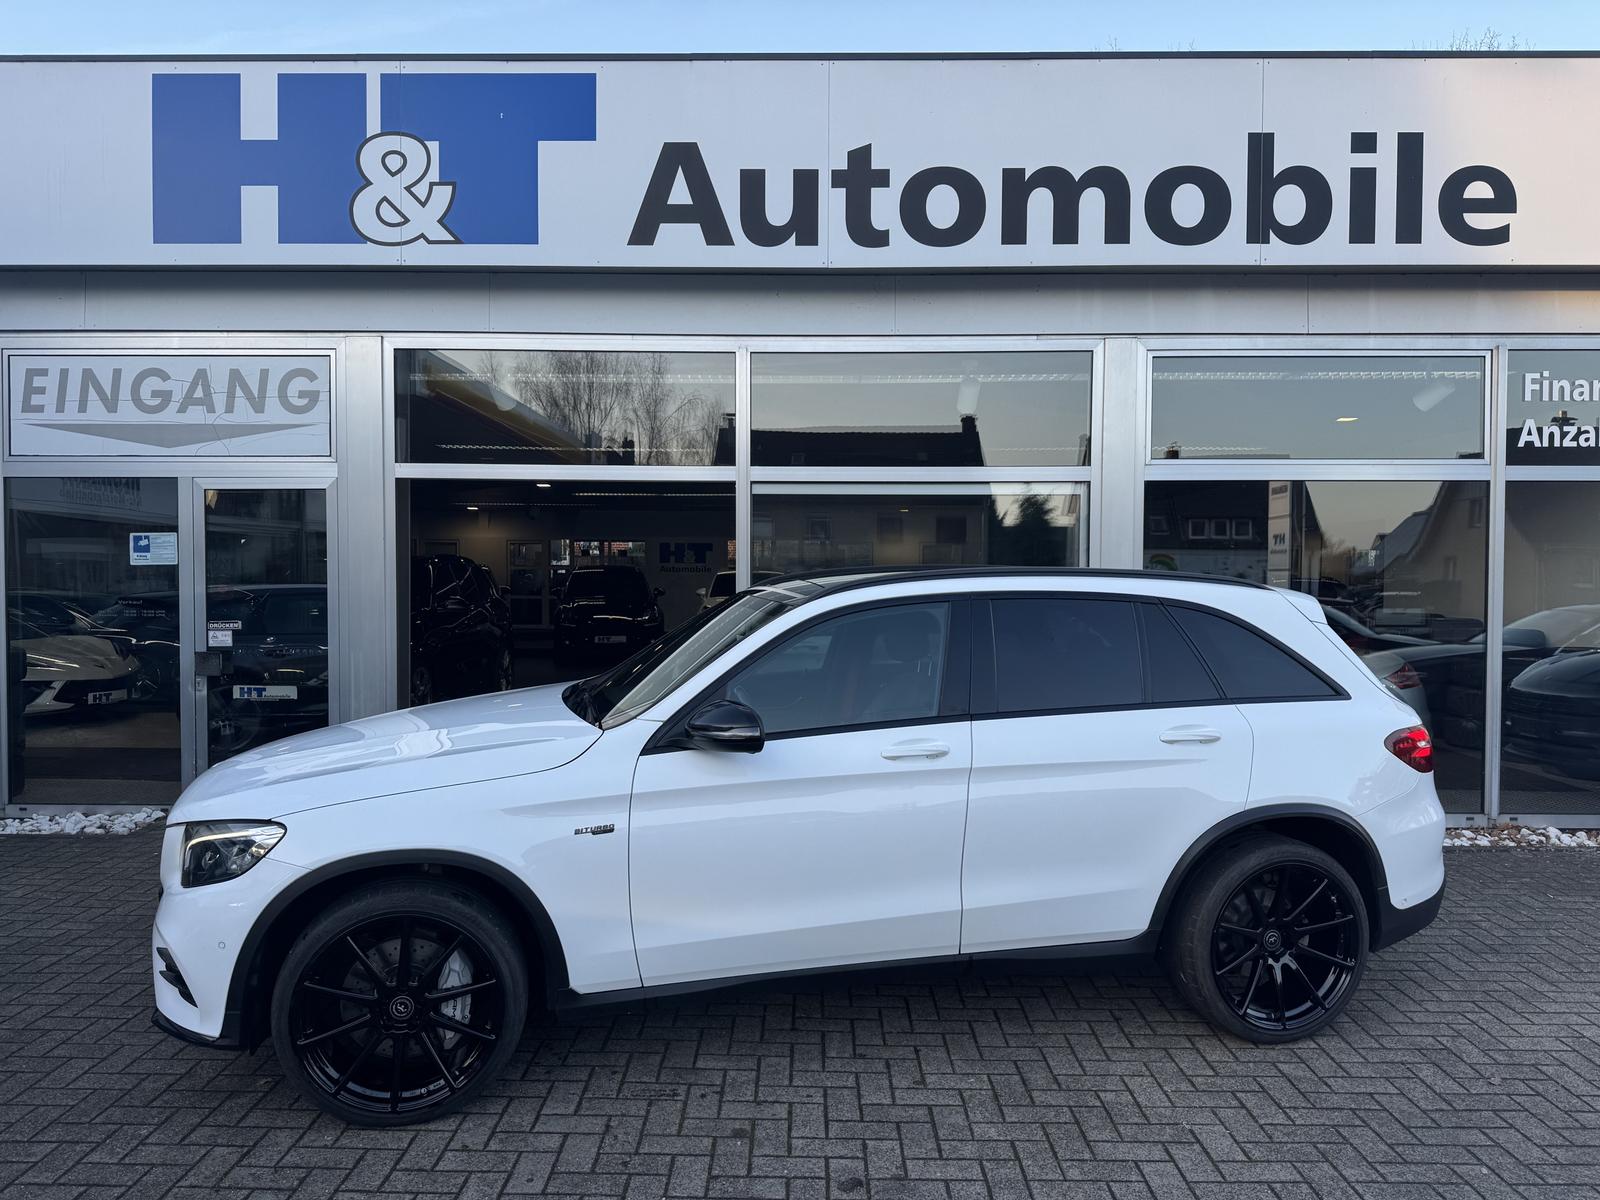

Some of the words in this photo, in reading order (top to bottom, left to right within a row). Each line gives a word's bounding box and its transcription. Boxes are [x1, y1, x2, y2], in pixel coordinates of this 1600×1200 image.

[152, 73, 596, 246] H&T
[627, 132, 1518, 248] Automobile
[21, 367, 321, 415] EINGANG
[1517, 418, 1600, 447] Anza
[574, 823, 615, 835] BITURBO
